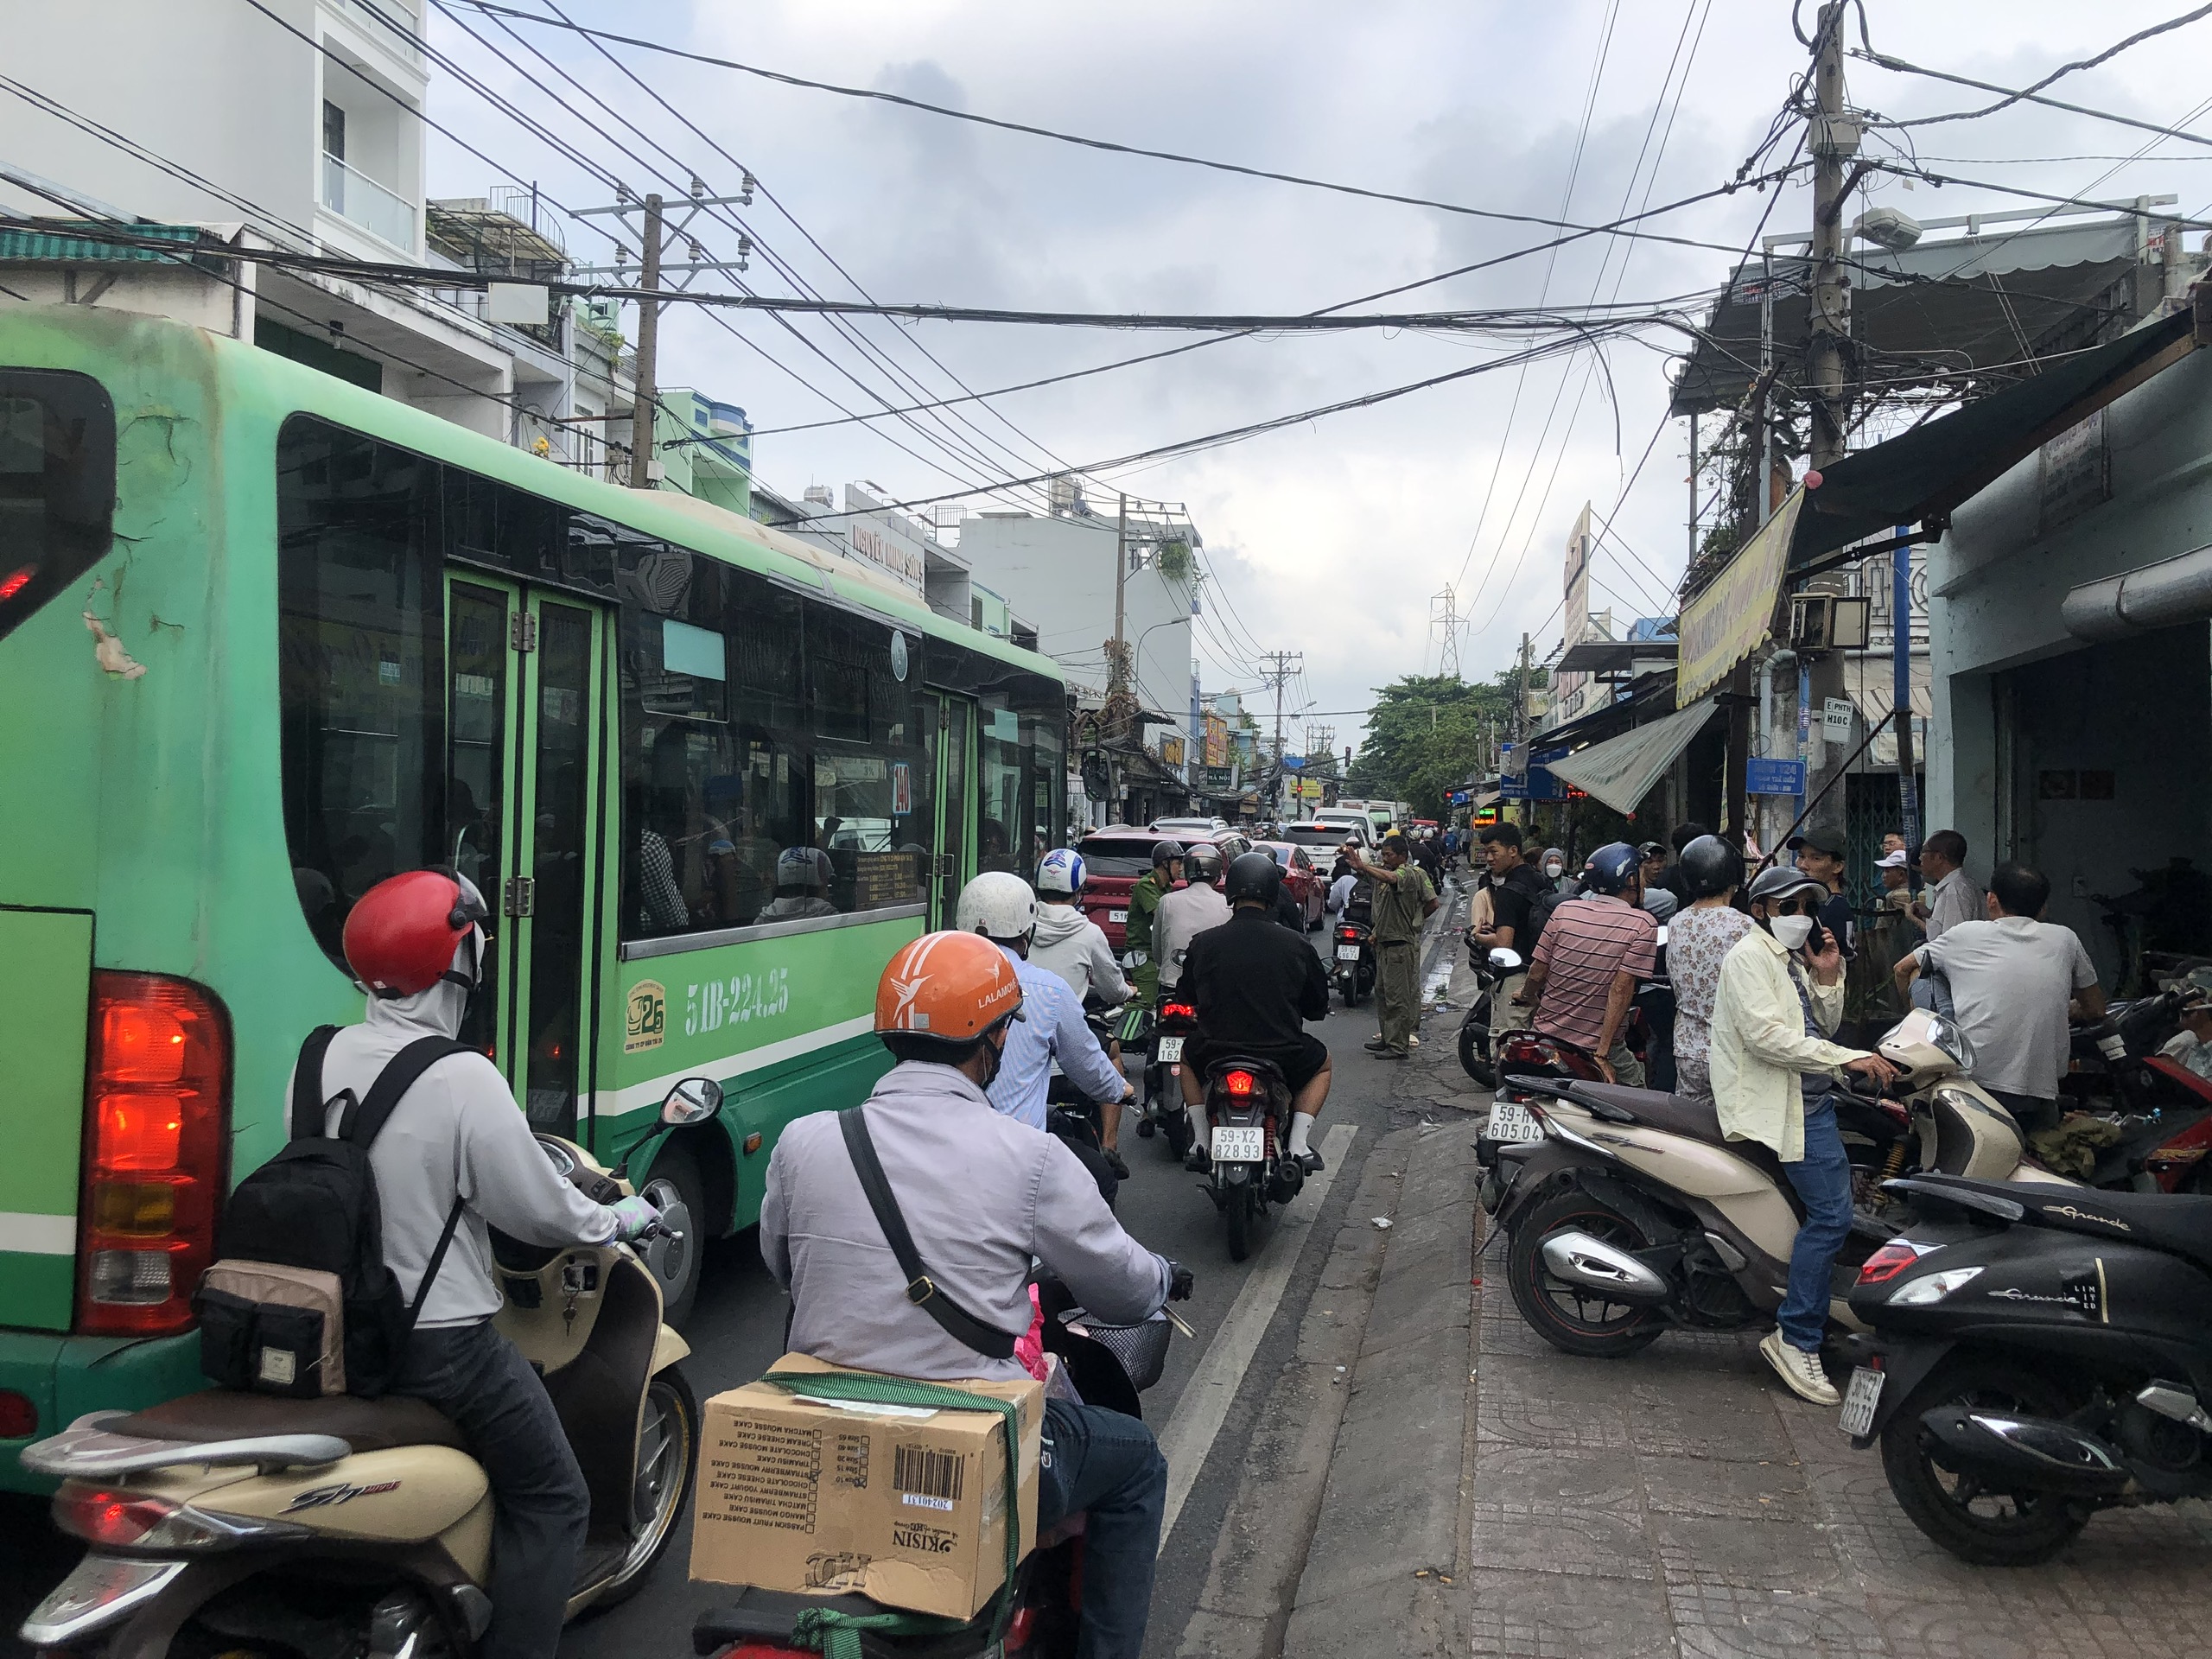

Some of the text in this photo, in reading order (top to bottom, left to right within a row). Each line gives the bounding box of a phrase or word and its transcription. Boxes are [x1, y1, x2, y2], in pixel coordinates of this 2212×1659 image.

[978, 977, 1017, 1009] LALAMOVE
[685, 967, 788, 1037] 51B-224.25
[641, 995, 664, 1034] 26
[1161, 1051, 1179, 1060] 162
[1220, 1130, 1255, 1143] 59-X2
[1491, 1123, 1539, 1141] 605.04
[1215, 1144, 1260, 1158] 828.93
[2043, 1206, 2131, 1231] Grande
[754, 1422, 782, 1432] MOUSSE
[784, 1427, 812, 1436] MATCHA
[737, 1431, 811, 1446] CREAM CHEESE CAKE
[719, 1440, 810, 1457] CHOCOLATE MOUSSE CAKE
[732, 1462, 760, 1471] MOUSSE
[778, 1458, 810, 1467] TIRAMISU
[761, 1467, 810, 1479] STRAWBERRY
[717, 1471, 808, 1489] CHOCOLATE CHEESE CAKE
[710, 1481, 807, 1499] STRAWBERRY YOGURT CAKE
[744, 1496, 776, 1505] TIRAMISU
[778, 1500, 806, 1510] MATCHA
[907, 1496, 948, 1509] 20240131
[729, 1504, 805, 1520] MANGO MOUSSE CAKE
[723, 1515, 752, 1524] MOUSSE
[753, 1518, 773, 1527] FRUIT
[774, 1522, 804, 1531] PASSION
[893, 1529, 939, 1553] KISIN
